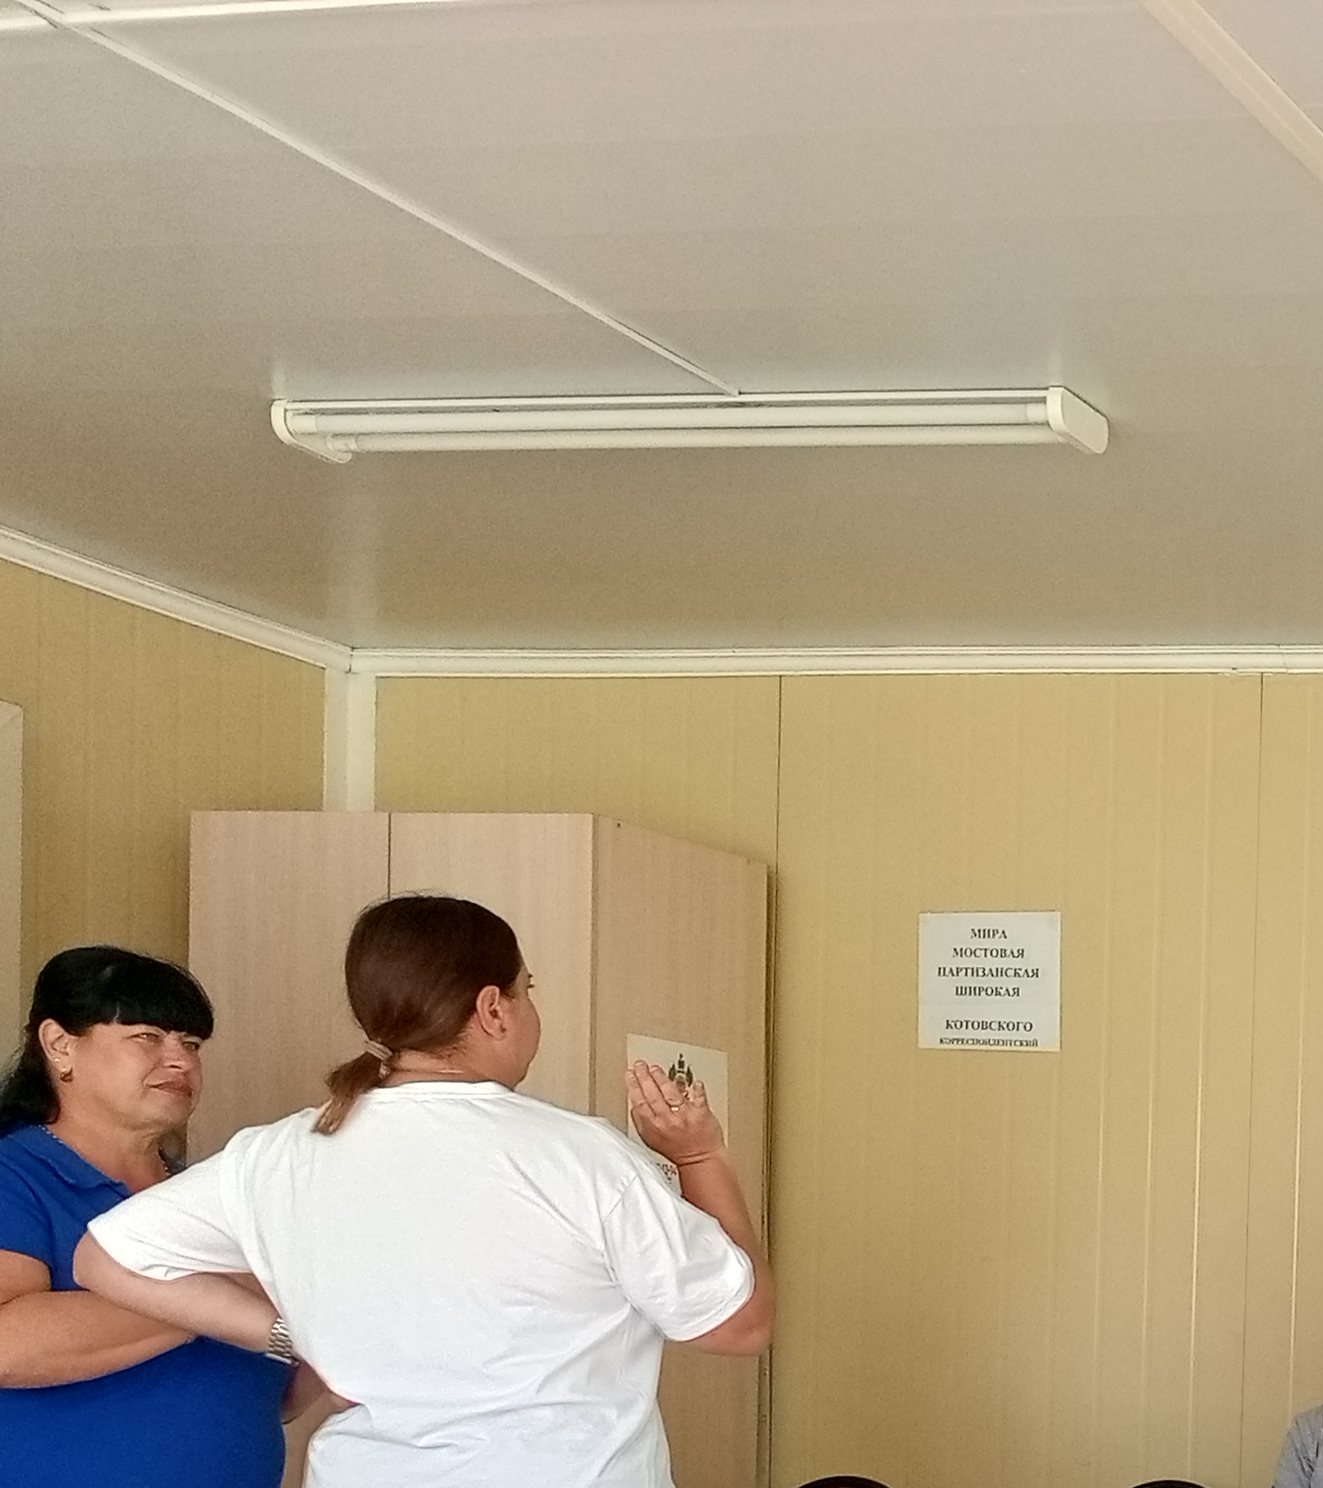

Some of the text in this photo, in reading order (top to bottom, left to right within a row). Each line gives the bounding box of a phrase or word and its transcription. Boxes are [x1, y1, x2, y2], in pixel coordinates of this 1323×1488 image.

[970, 928, 1007, 939] МИРА
[952, 947, 1025, 959] МОСТОВАЯ
[937, 966, 1039, 978] ПАРТИЗАНСКАЯ
[955, 986, 1020, 997] ШИРОКАЯ
[945, 1020, 1034, 1032] КОТОВСКОГО
